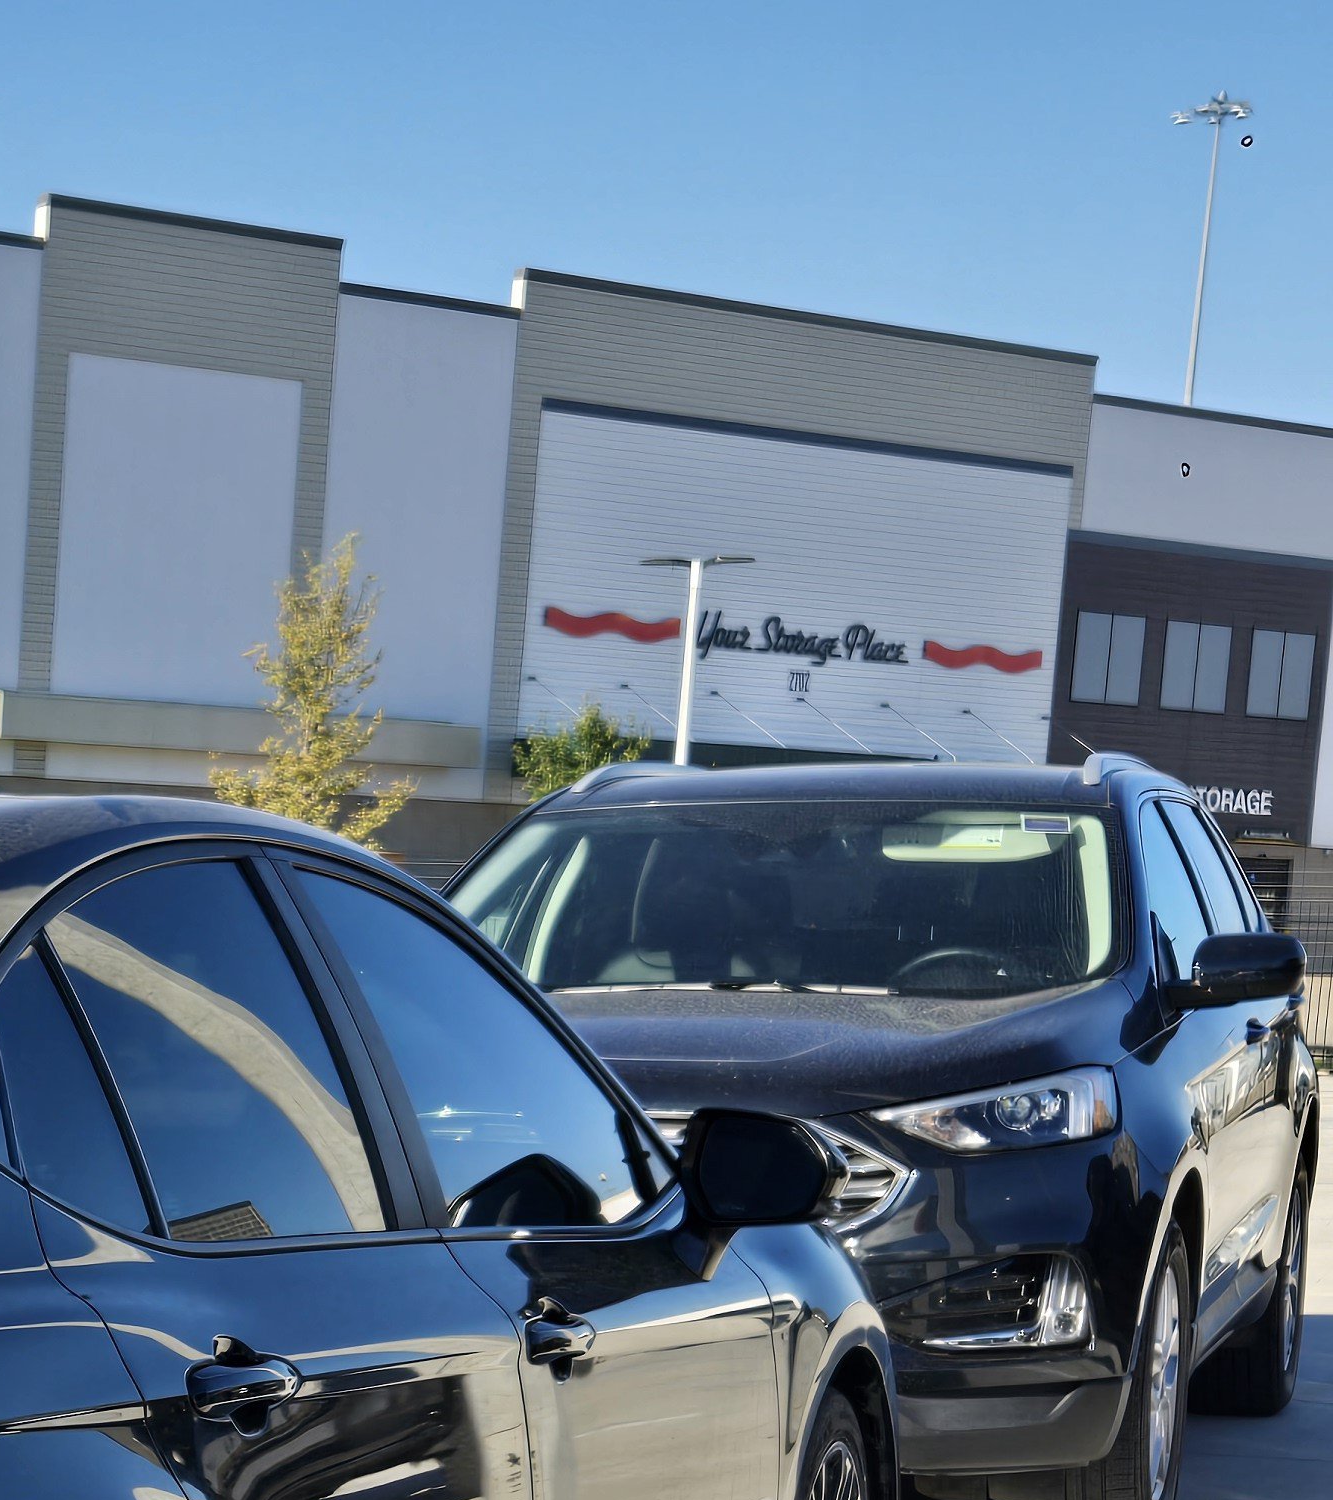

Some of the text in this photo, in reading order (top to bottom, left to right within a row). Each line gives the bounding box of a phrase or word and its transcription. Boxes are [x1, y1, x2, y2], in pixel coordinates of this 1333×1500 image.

[696, 610, 910, 667] Your Storage Place
